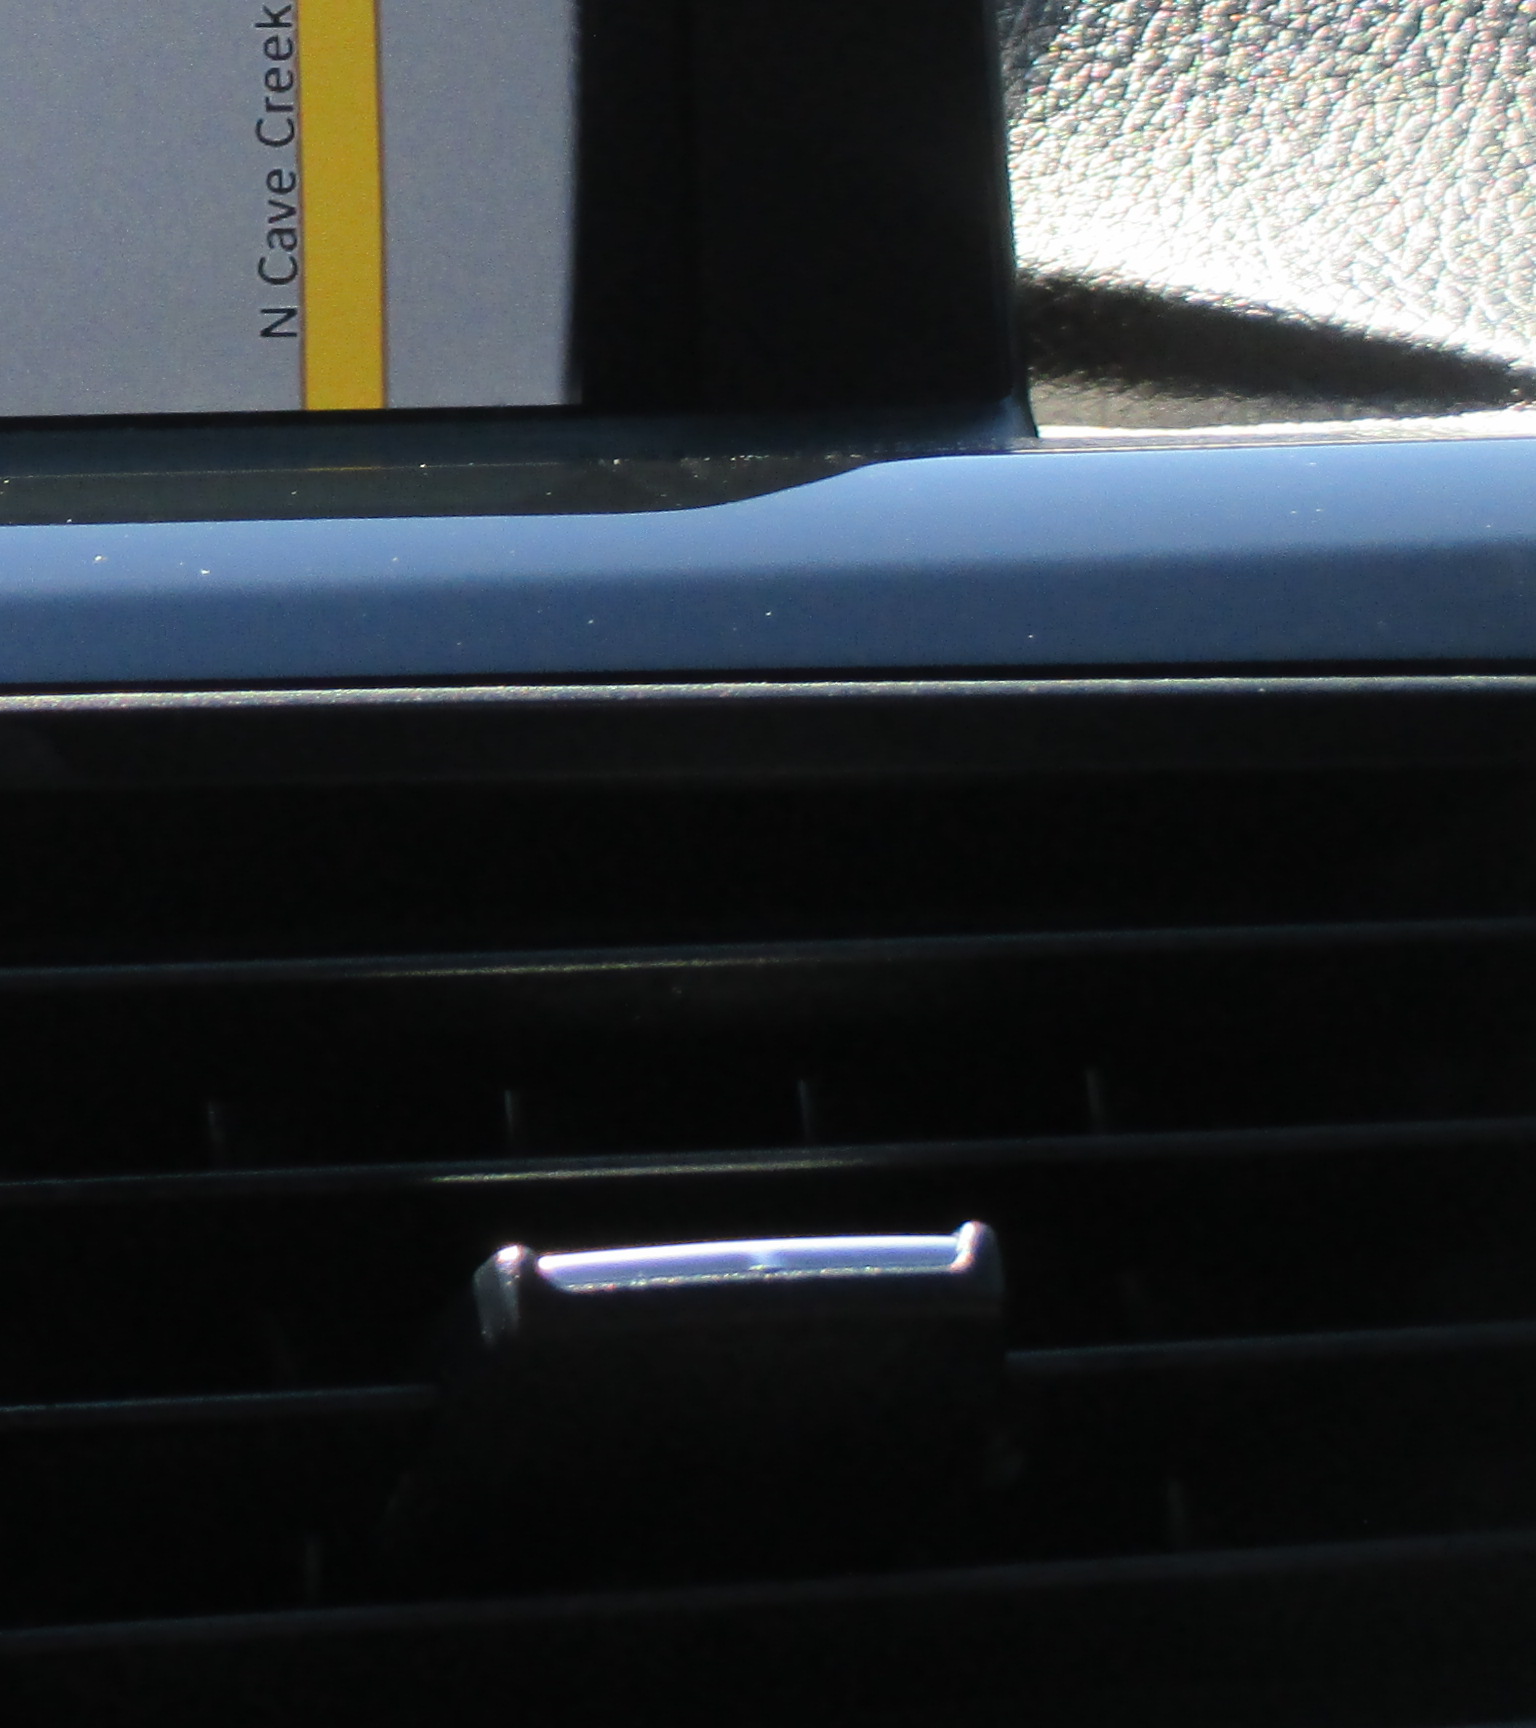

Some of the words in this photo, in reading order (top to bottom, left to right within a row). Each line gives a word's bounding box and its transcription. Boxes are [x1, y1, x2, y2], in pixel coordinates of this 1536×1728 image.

[254, 2, 297, 149] Creek
[257, 168, 298, 286] Cave
[259, 307, 298, 338] N
